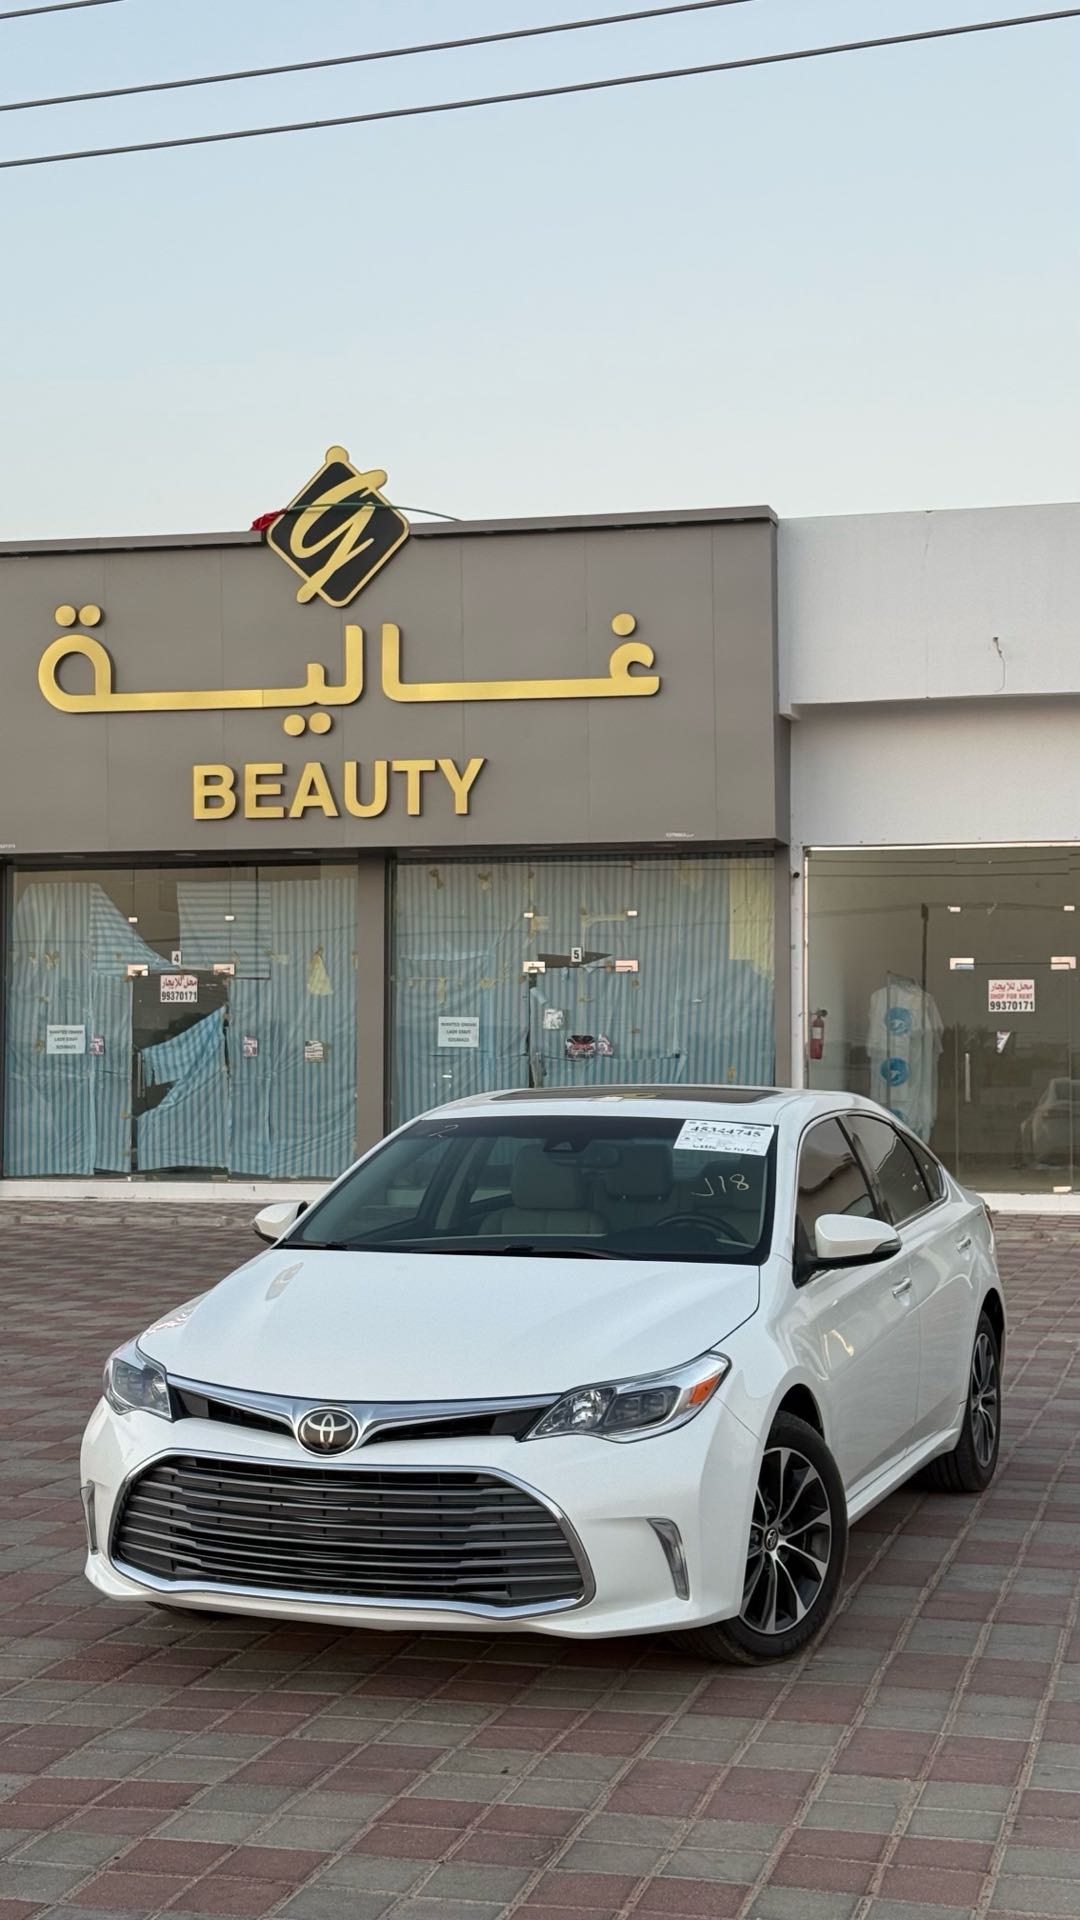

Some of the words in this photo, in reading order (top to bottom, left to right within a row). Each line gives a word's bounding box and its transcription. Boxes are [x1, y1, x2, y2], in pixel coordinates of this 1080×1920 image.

[38, 603, 660, 737] غالية
[193, 758, 487, 820] BEAUTY
[173, 953, 180, 963] 4
[573, 949, 580, 960] 5
[183, 977, 197, 989] محل
[1016, 982, 1033, 992] محل
[161, 991, 197, 1001] 99370171
[990, 1001, 1033, 1010] 99370171
